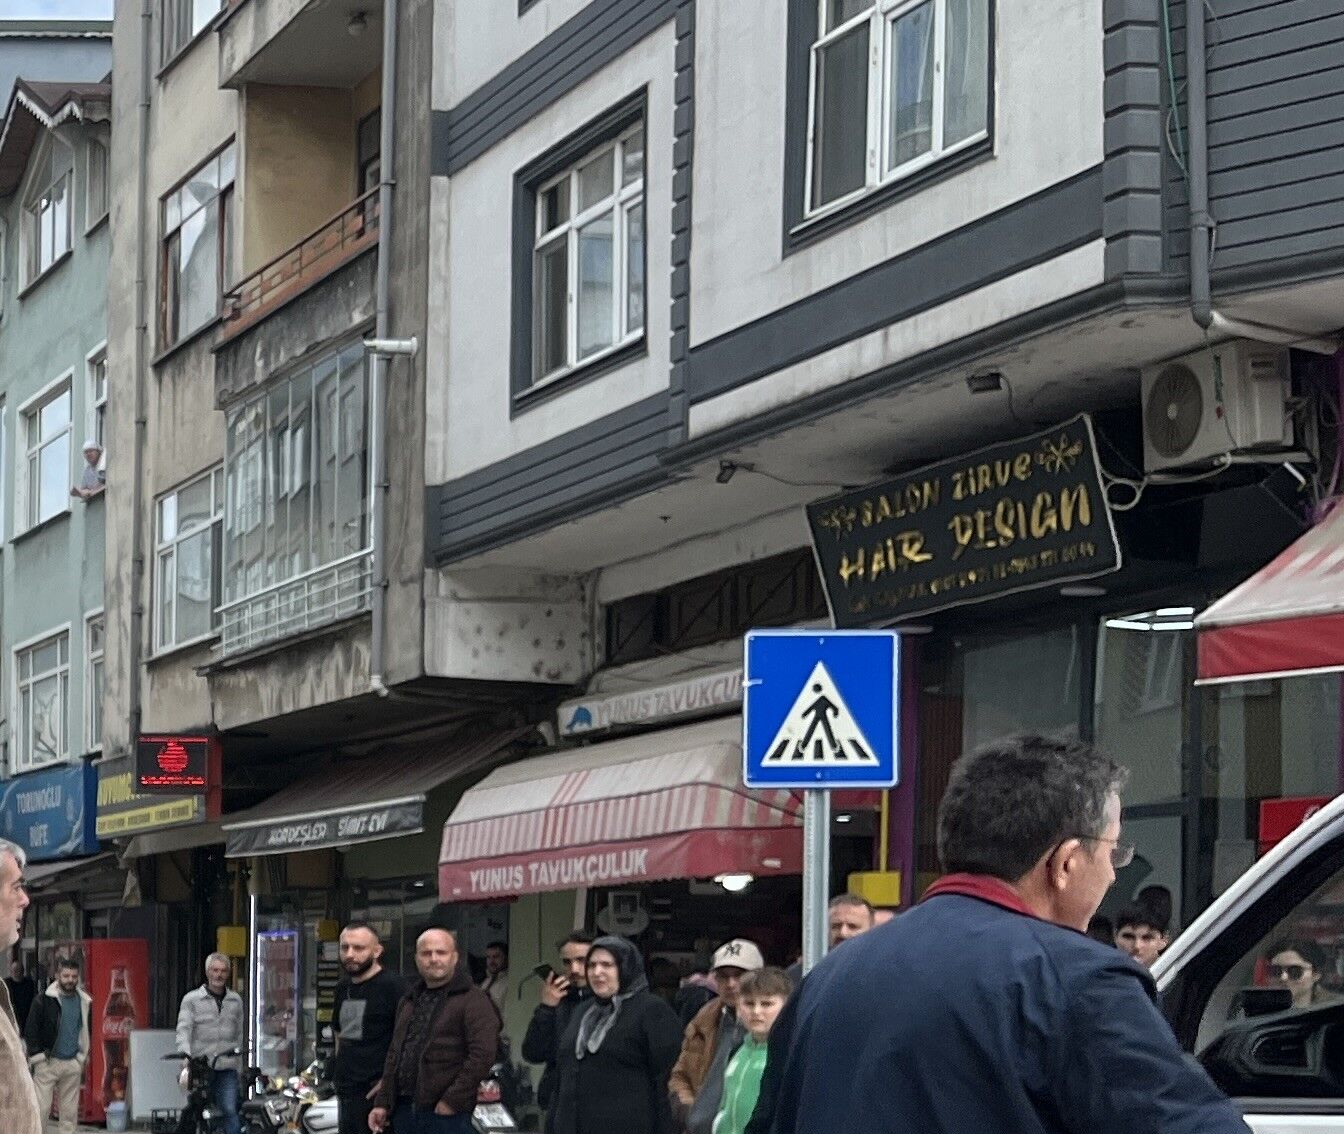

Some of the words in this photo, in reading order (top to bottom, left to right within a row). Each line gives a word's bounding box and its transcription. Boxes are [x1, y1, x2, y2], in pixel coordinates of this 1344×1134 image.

[948, 483, 1091, 561] DESIGN
[469, 865, 524, 893] YUNUS
[528, 849, 649, 887] TAVUKÇULUK
